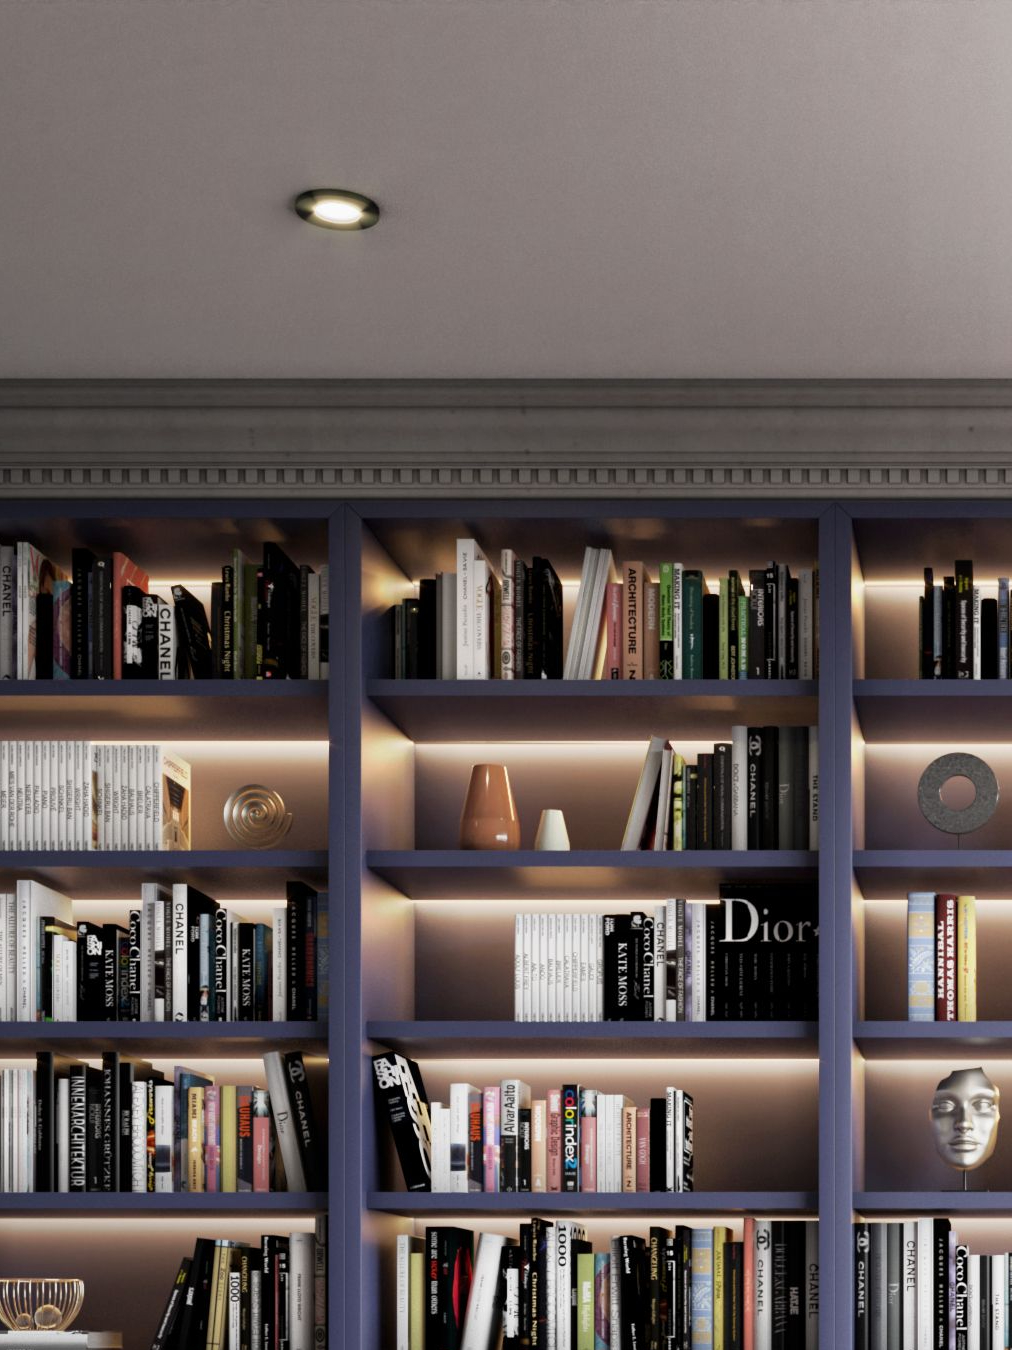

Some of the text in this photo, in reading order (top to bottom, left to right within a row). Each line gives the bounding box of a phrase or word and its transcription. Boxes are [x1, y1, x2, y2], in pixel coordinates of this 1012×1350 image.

[2, 565, 12, 617] CHANEL
[628, 568, 636, 654] ARCHITECTURE
[757, 588, 765, 627] INTERIORS
[160, 608, 171, 679] CHANEL
[779, 784, 790, 804] Dior
[175, 903, 184, 954] CHANEL
[656, 922, 664, 967] CHANEL
[718, 898, 812, 943] Dior
[129, 910, 140, 994] Coco Chanel
[215, 909, 226, 993] Coco Chanel
[618, 942, 627, 1007] KATE MOSS
[643, 917, 654, 998] Coco Chanel
[946, 899, 954, 1021] THOMAS HARRIS
[104, 950, 114, 1007] KATE MOSS
[241, 948, 251, 1007] KATE MOSS
[71, 1076, 85, 1186] INNENARCHITEKTUR
[103, 1069, 112, 1191] JOHANNES GRÜTZKE
[277, 1112, 289, 1134] Dior
[295, 1090, 311, 1148] CHANEL
[549, 1112, 559, 1156] Graphic Design
[316, 1248, 324, 1271] ORWELL
[558, 1225, 566, 1267] 1000
[650, 1237, 658, 1280] CHANGELING
[907, 1241, 915, 1291] CHANEL
[230, 1275, 240, 1302] 1000
[789, 1286, 799, 1315] HATJE
[809, 1263, 819, 1319] CHANEL
[888, 1282, 899, 1305] Dior
[956, 1246, 968, 1330] Coco Chanel
